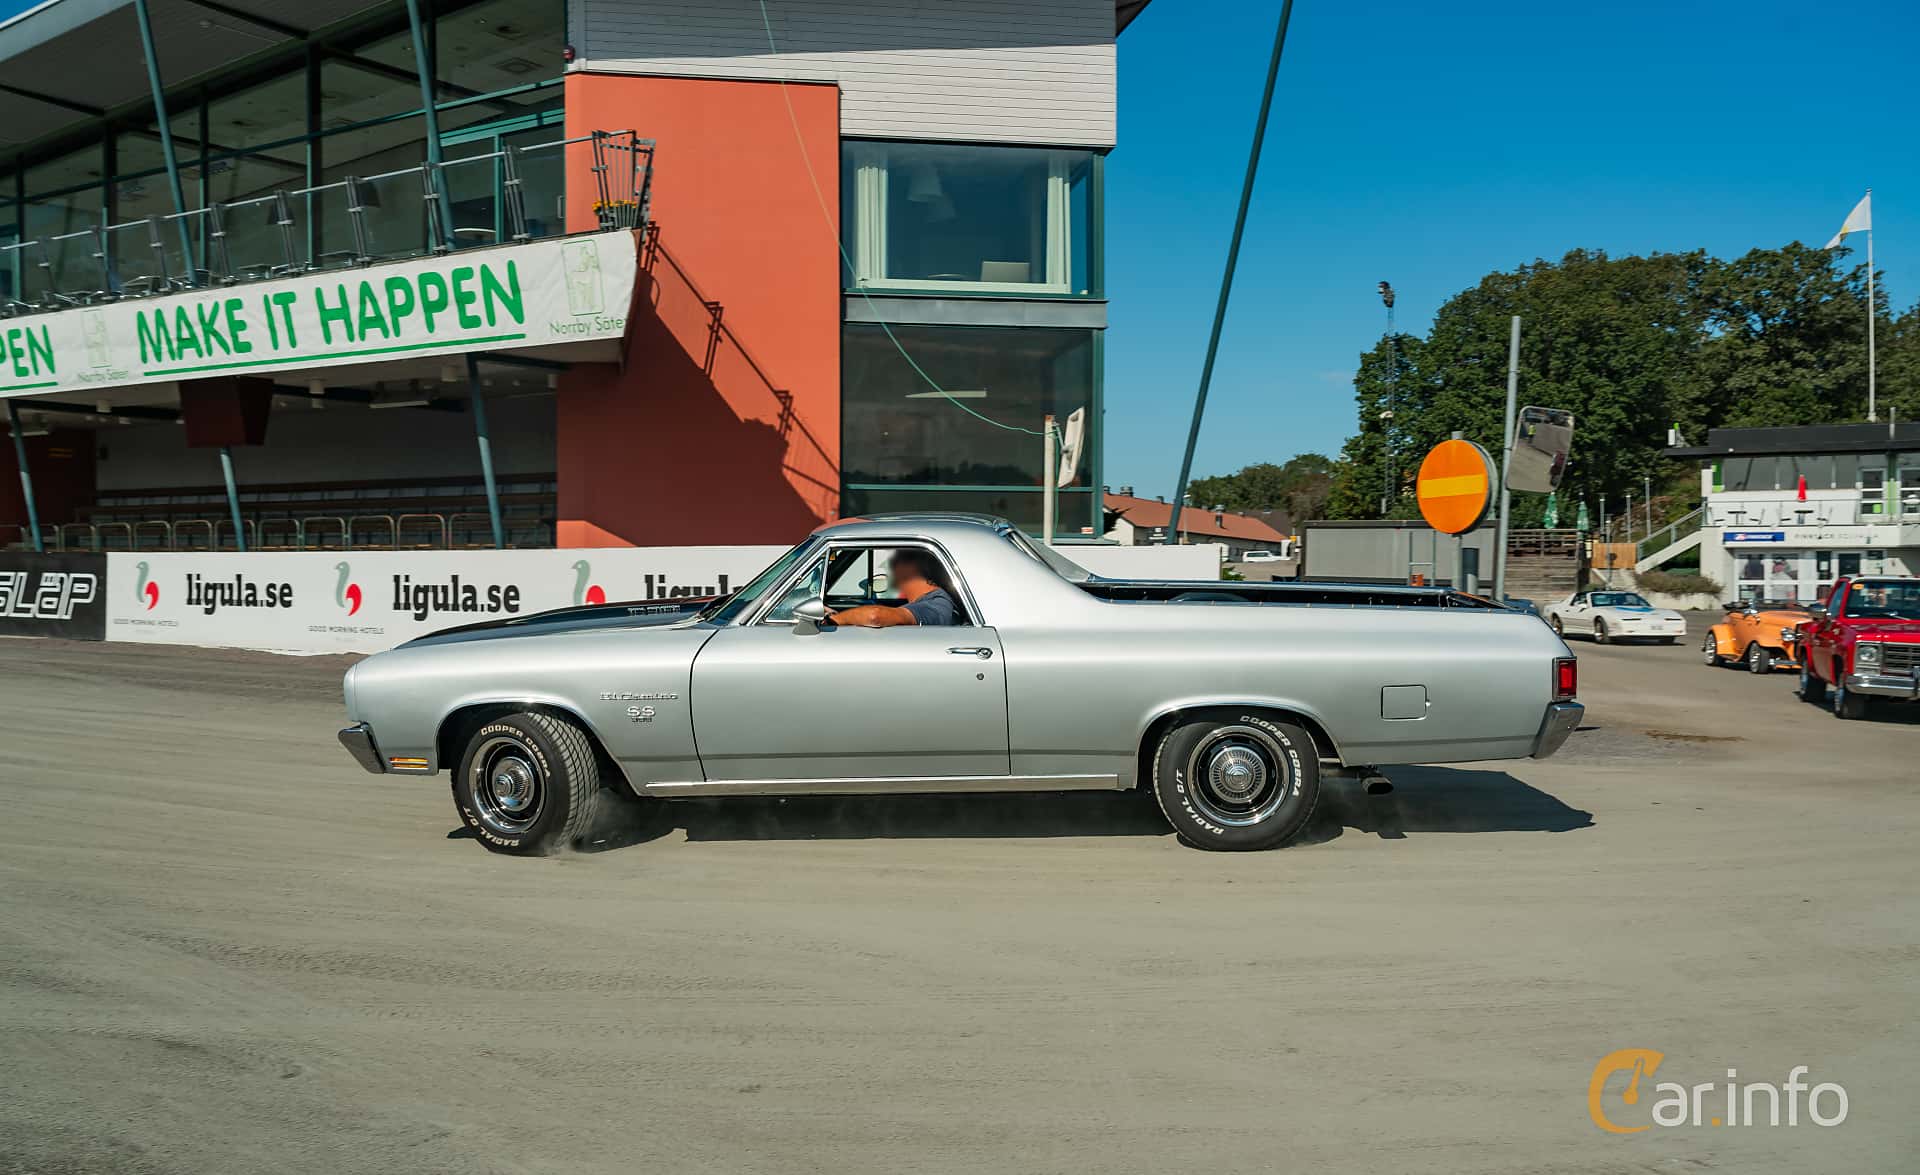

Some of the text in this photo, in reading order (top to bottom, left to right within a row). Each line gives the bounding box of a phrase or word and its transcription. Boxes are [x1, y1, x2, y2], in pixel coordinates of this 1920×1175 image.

[136, 259, 526, 364] MAKE IT HAPPEN
[186, 573, 293, 615] ligula.se
[392, 574, 521, 622] ligula.se
[627, 705, 656, 717] SS
[480, 724, 551, 778] COOPER COBRA
[1239, 715, 1302, 797] COOPER COBRA
[480, 827, 520, 847] RADIAL
[1181, 796, 1225, 836] RADIAL
